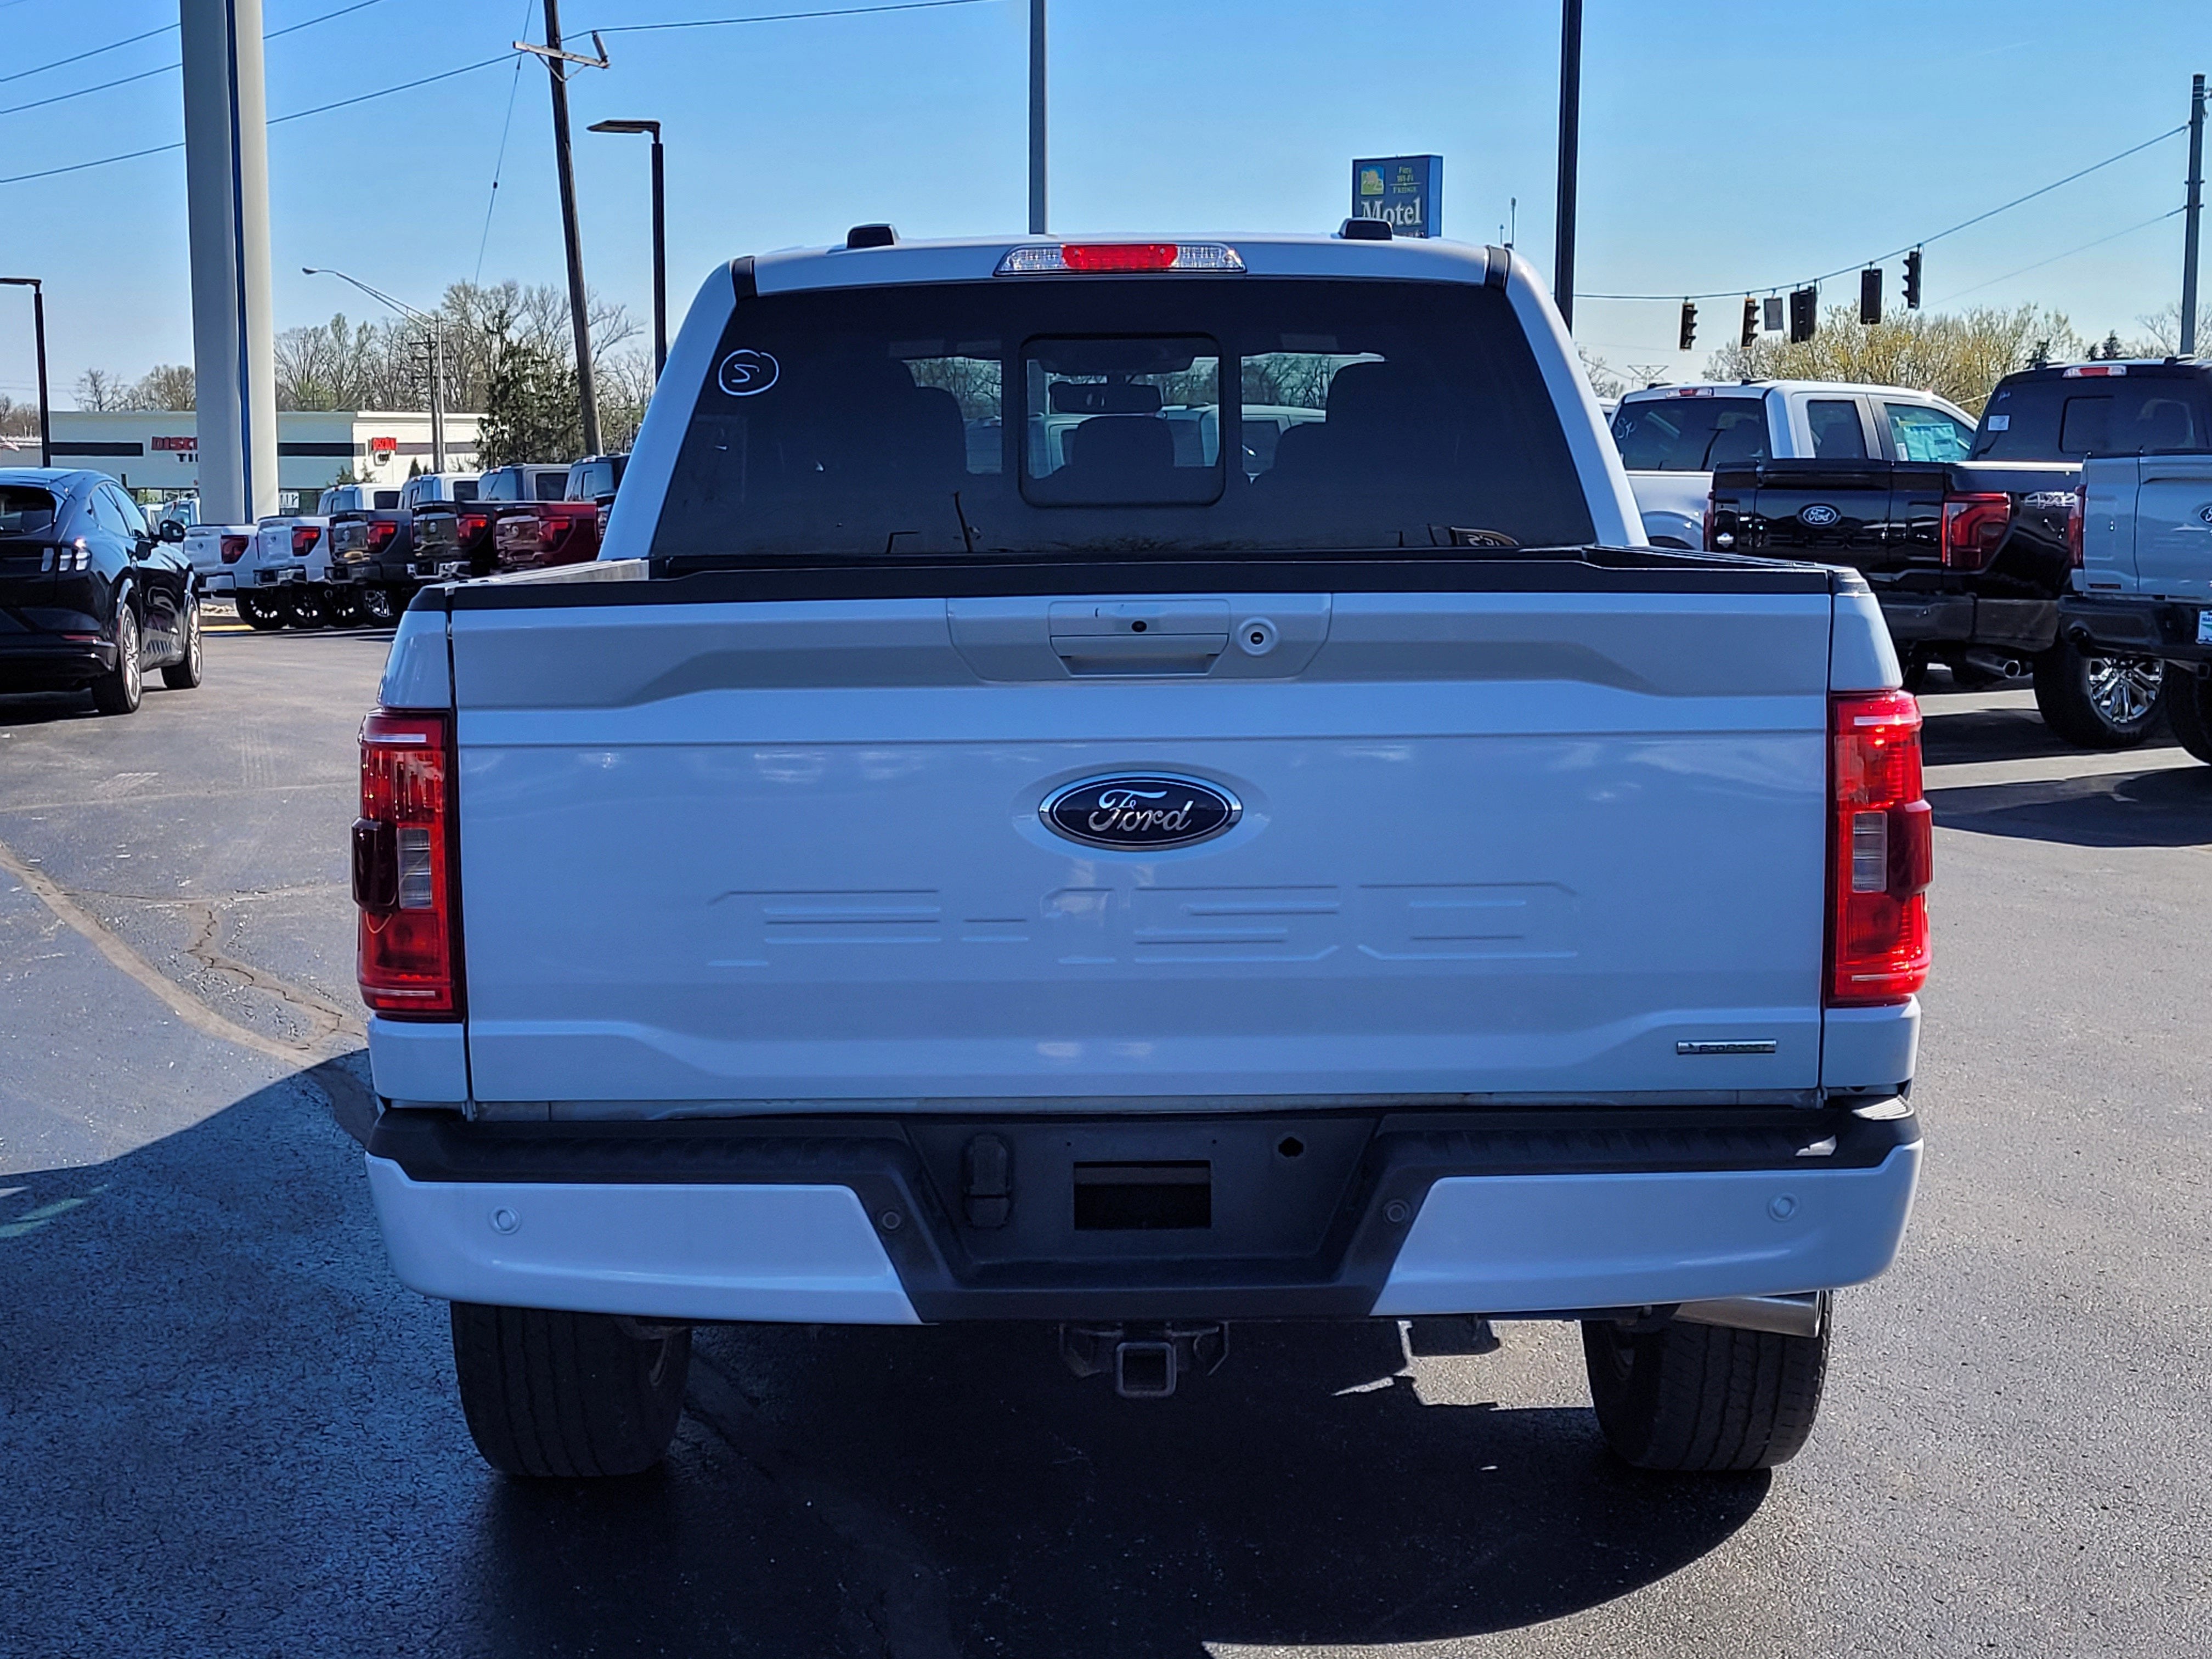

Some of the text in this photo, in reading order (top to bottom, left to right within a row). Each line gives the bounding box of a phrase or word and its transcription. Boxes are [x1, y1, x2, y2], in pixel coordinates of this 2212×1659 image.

[1361, 197, 1423, 225] Motel
[151, 436, 198, 450] DISC
[1808, 509, 1831, 521] Ford
[1088, 788, 1194, 832] Ford
